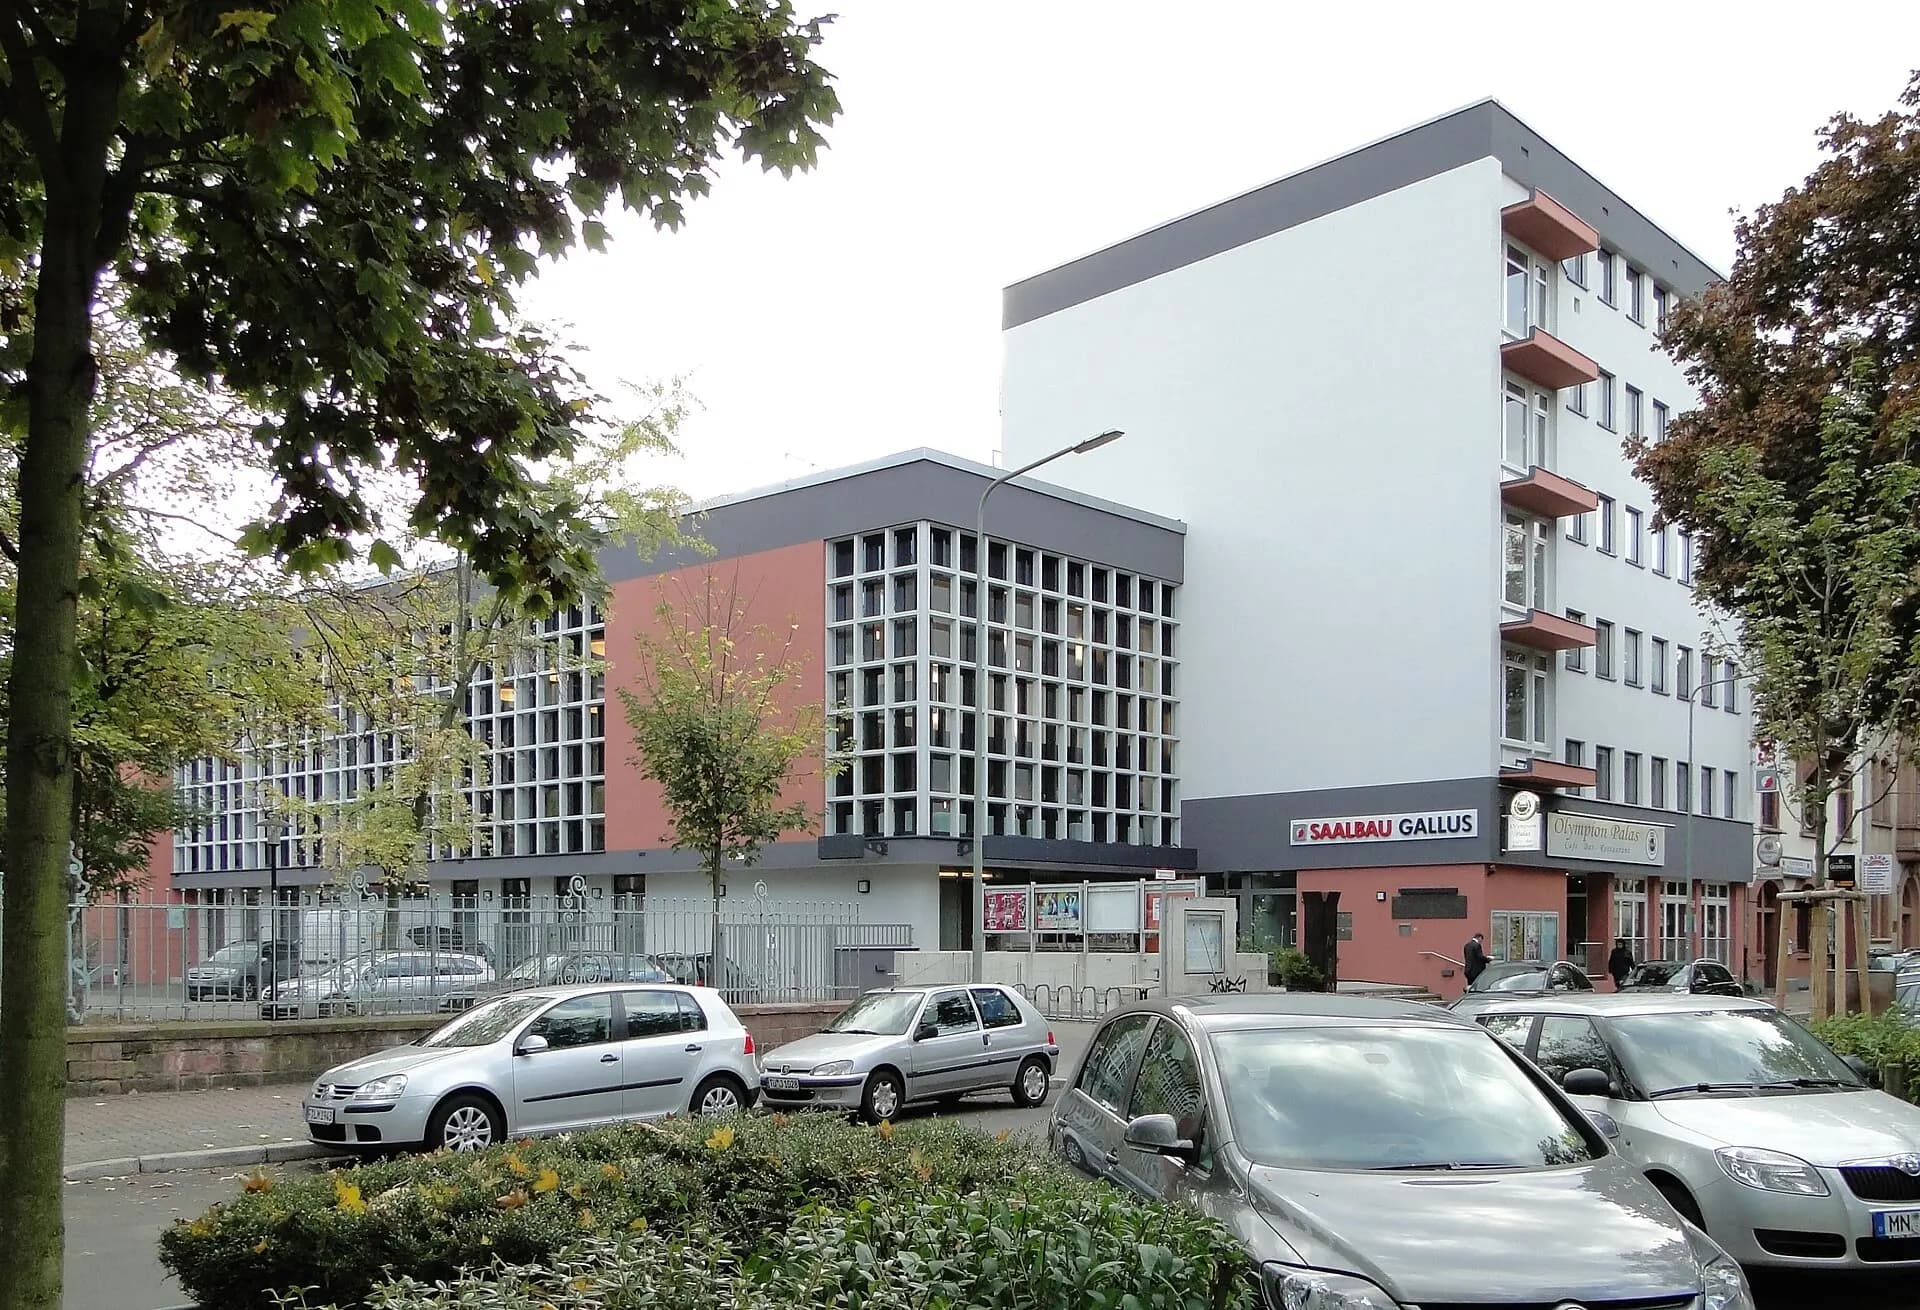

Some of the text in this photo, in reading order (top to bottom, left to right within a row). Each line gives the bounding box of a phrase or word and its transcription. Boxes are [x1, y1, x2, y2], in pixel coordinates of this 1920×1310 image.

[1310, 815, 1473, 840] SAALBAU GALLUS
[1554, 817, 1640, 842] Olympion Palas
[1889, 1215, 1910, 1232] MN
